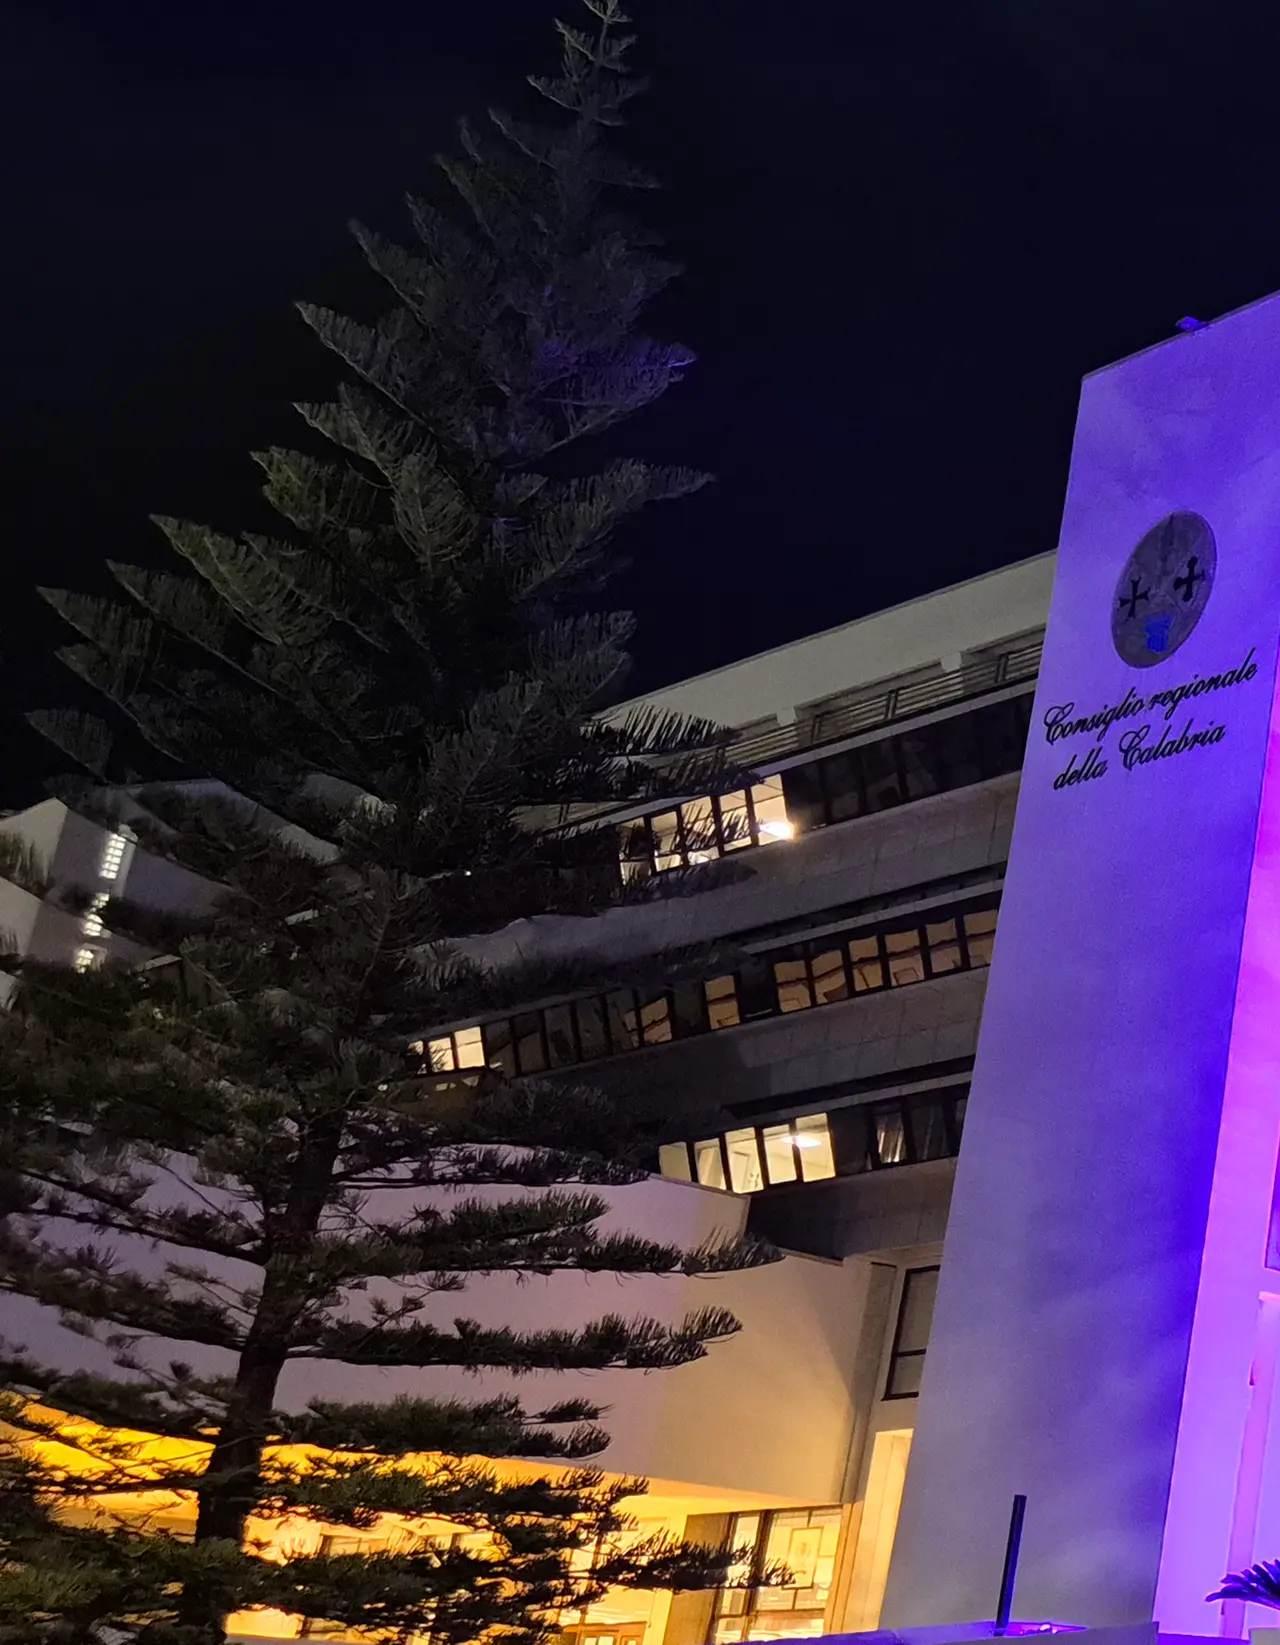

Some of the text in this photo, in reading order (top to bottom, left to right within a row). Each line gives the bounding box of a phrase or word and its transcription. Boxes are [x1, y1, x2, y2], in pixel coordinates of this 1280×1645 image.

[1043, 647, 1258, 745] Consiglio regionale
[1053, 718, 1226, 791] della Calabria
